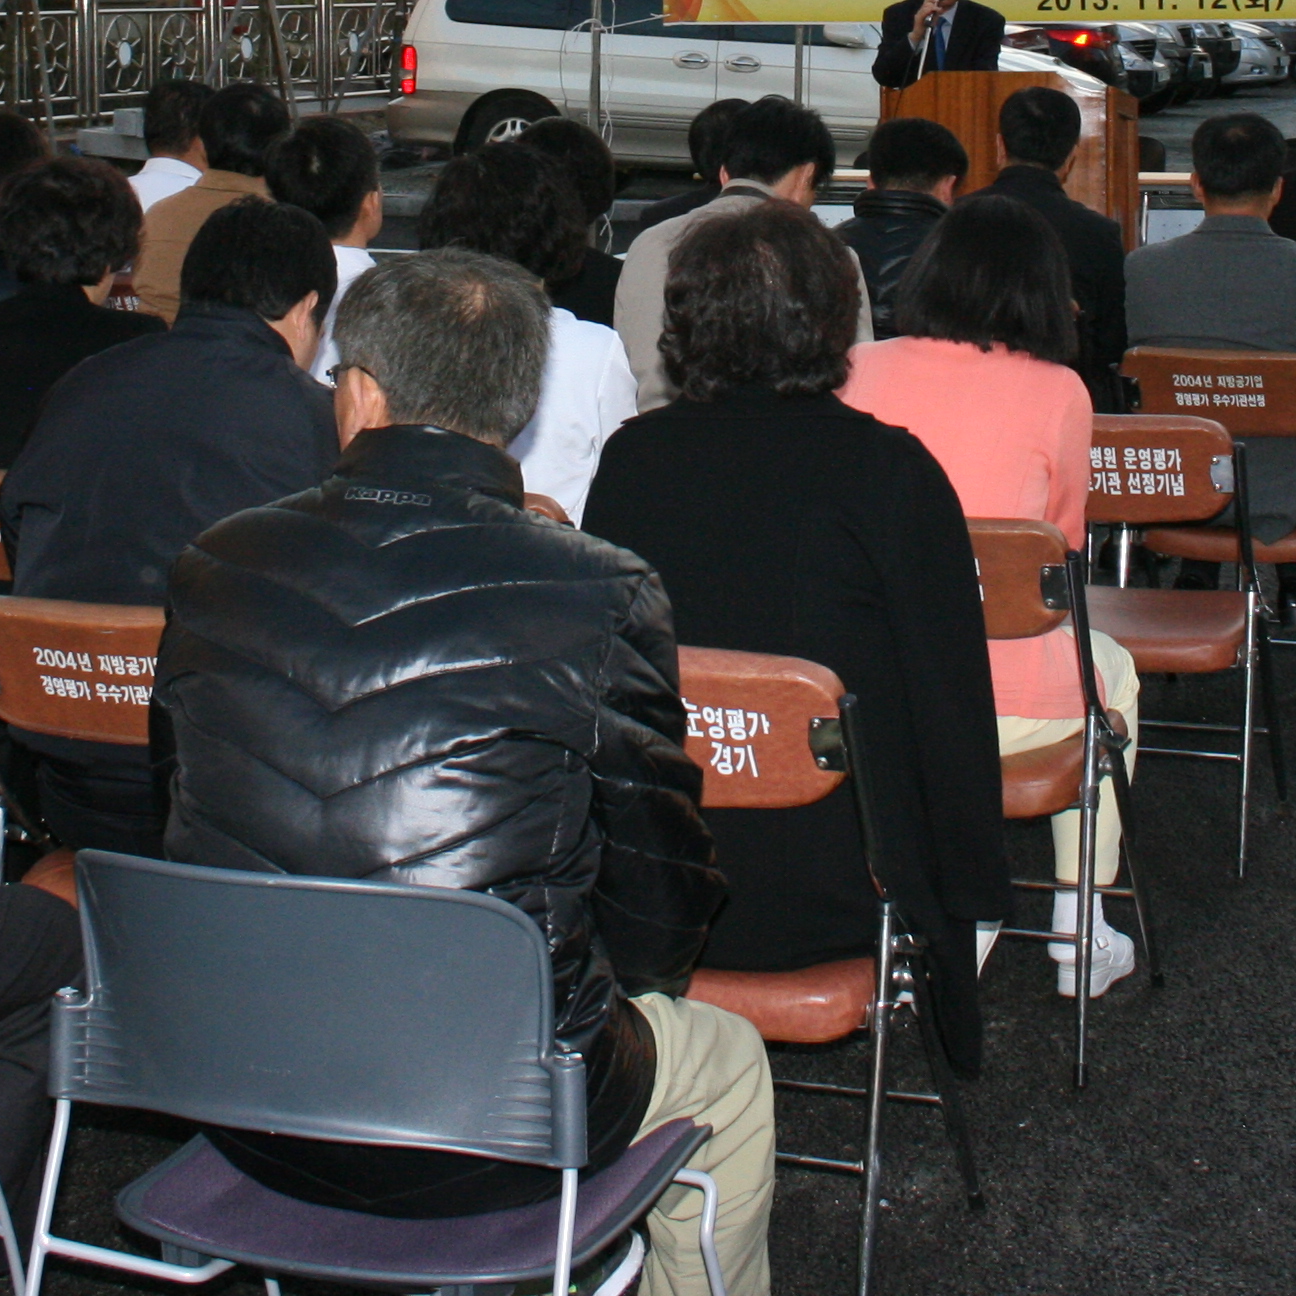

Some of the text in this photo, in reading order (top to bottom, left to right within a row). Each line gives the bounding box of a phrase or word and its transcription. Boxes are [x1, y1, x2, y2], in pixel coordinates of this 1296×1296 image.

[1172, 373, 1213, 388] 2004년
[1123, 447, 1182, 472] 운영평가
[344, 487, 431, 506] Kappa
[1088, 471, 1186, 497] 기관 선정기념
[32, 647, 158, 677] 2004년 지방공기
[39, 675, 153, 707] 경영평가 우수기관
